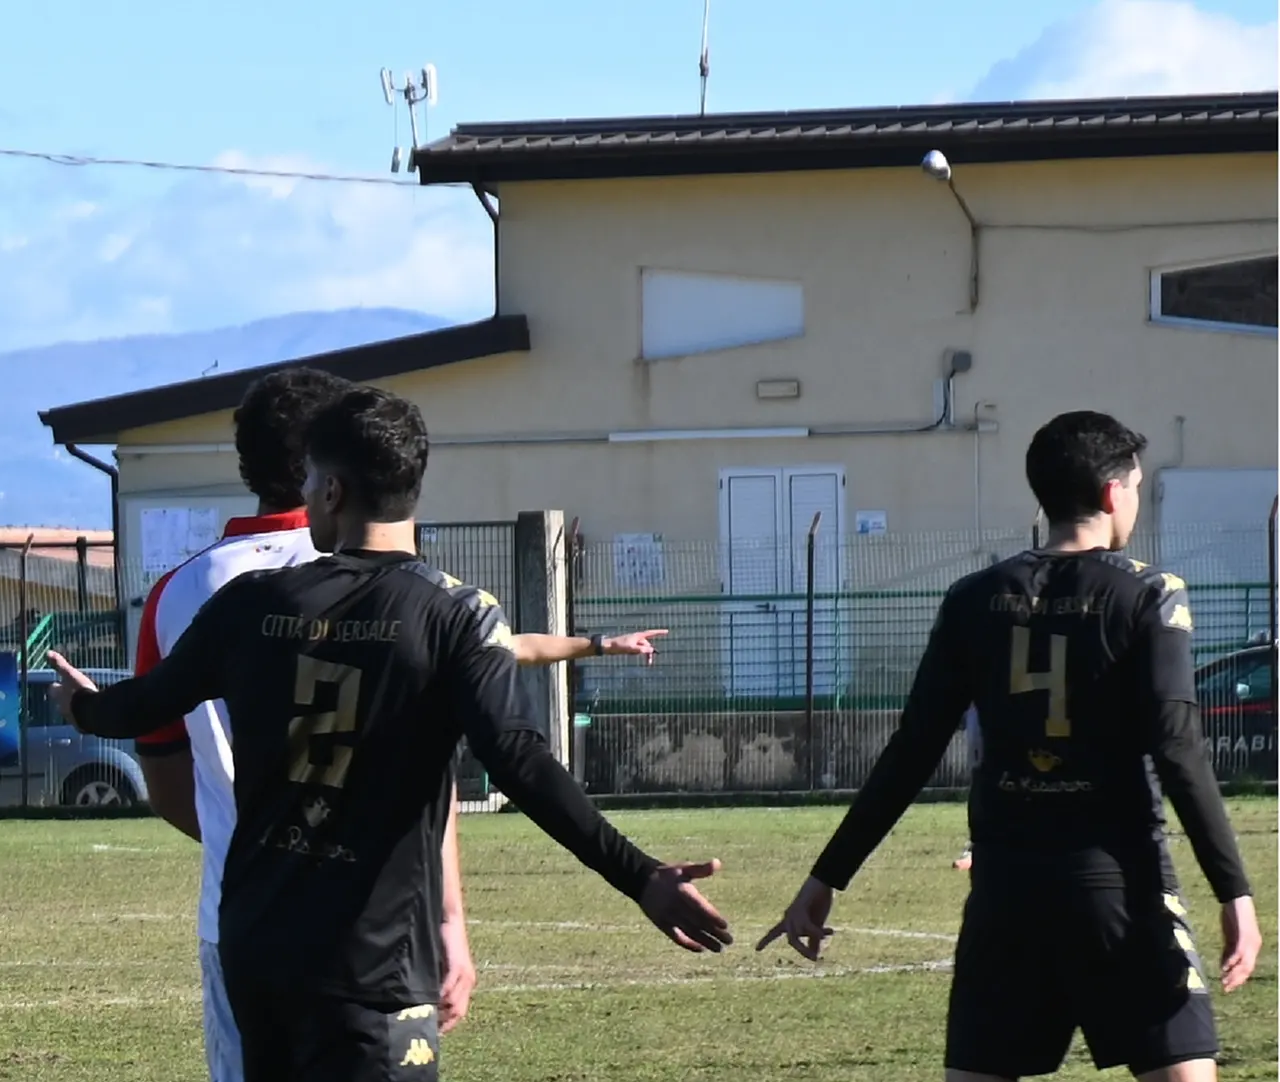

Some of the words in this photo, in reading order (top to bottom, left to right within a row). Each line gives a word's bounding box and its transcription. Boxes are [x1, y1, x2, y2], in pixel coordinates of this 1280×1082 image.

[261, 613, 304, 640] CITTÀ
[308, 617, 330, 641] DI
[333, 620, 402, 643] SERSALE
[1009, 625, 1071, 737] 4
[288, 654, 363, 788] 2
